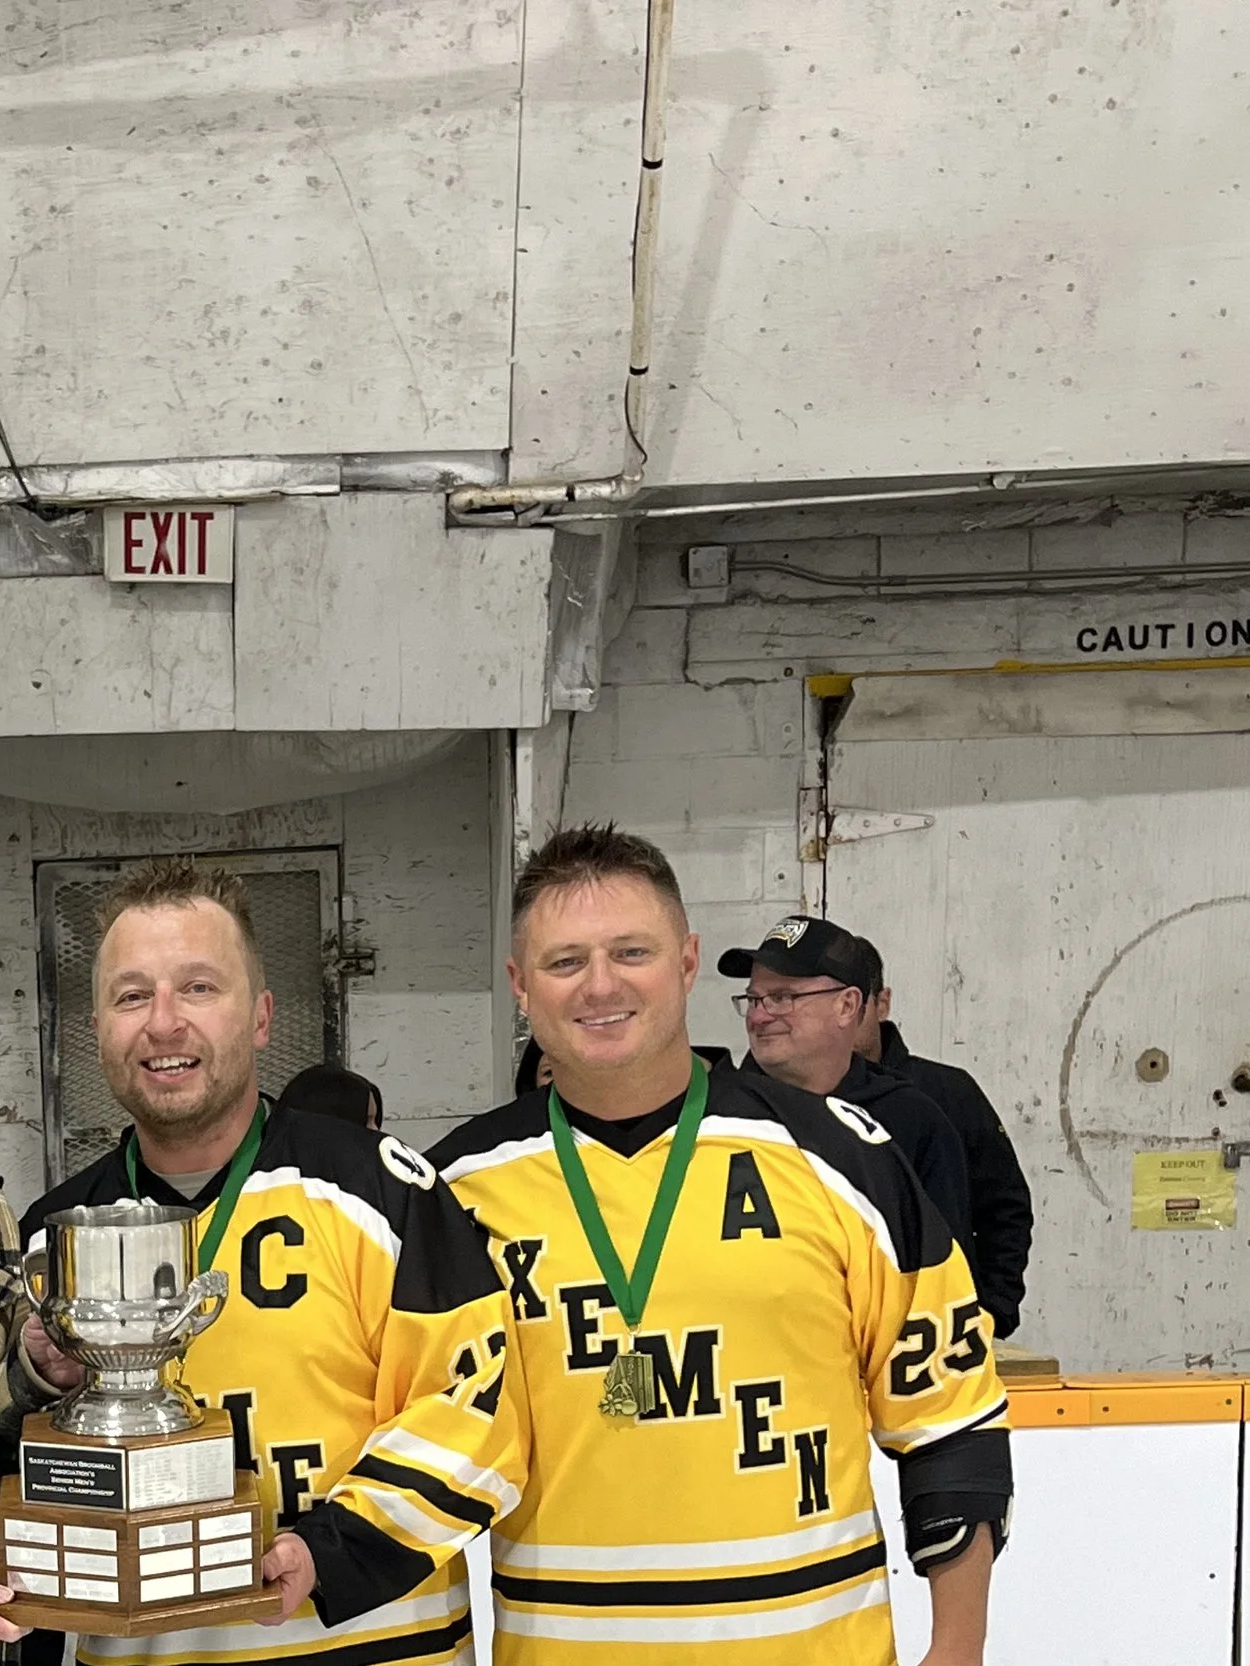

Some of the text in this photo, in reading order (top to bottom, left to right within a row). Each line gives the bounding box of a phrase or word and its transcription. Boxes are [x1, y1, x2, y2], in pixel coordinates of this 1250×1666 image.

[124, 512, 214, 575] EXIT
[1077, 619, 1250, 652] CAUTION
[720, 1150, 782, 1240] A
[1160, 1160, 1206, 1169] KEEP OUT
[241, 1215, 307, 1308] C
[890, 1300, 988, 1396] 25
